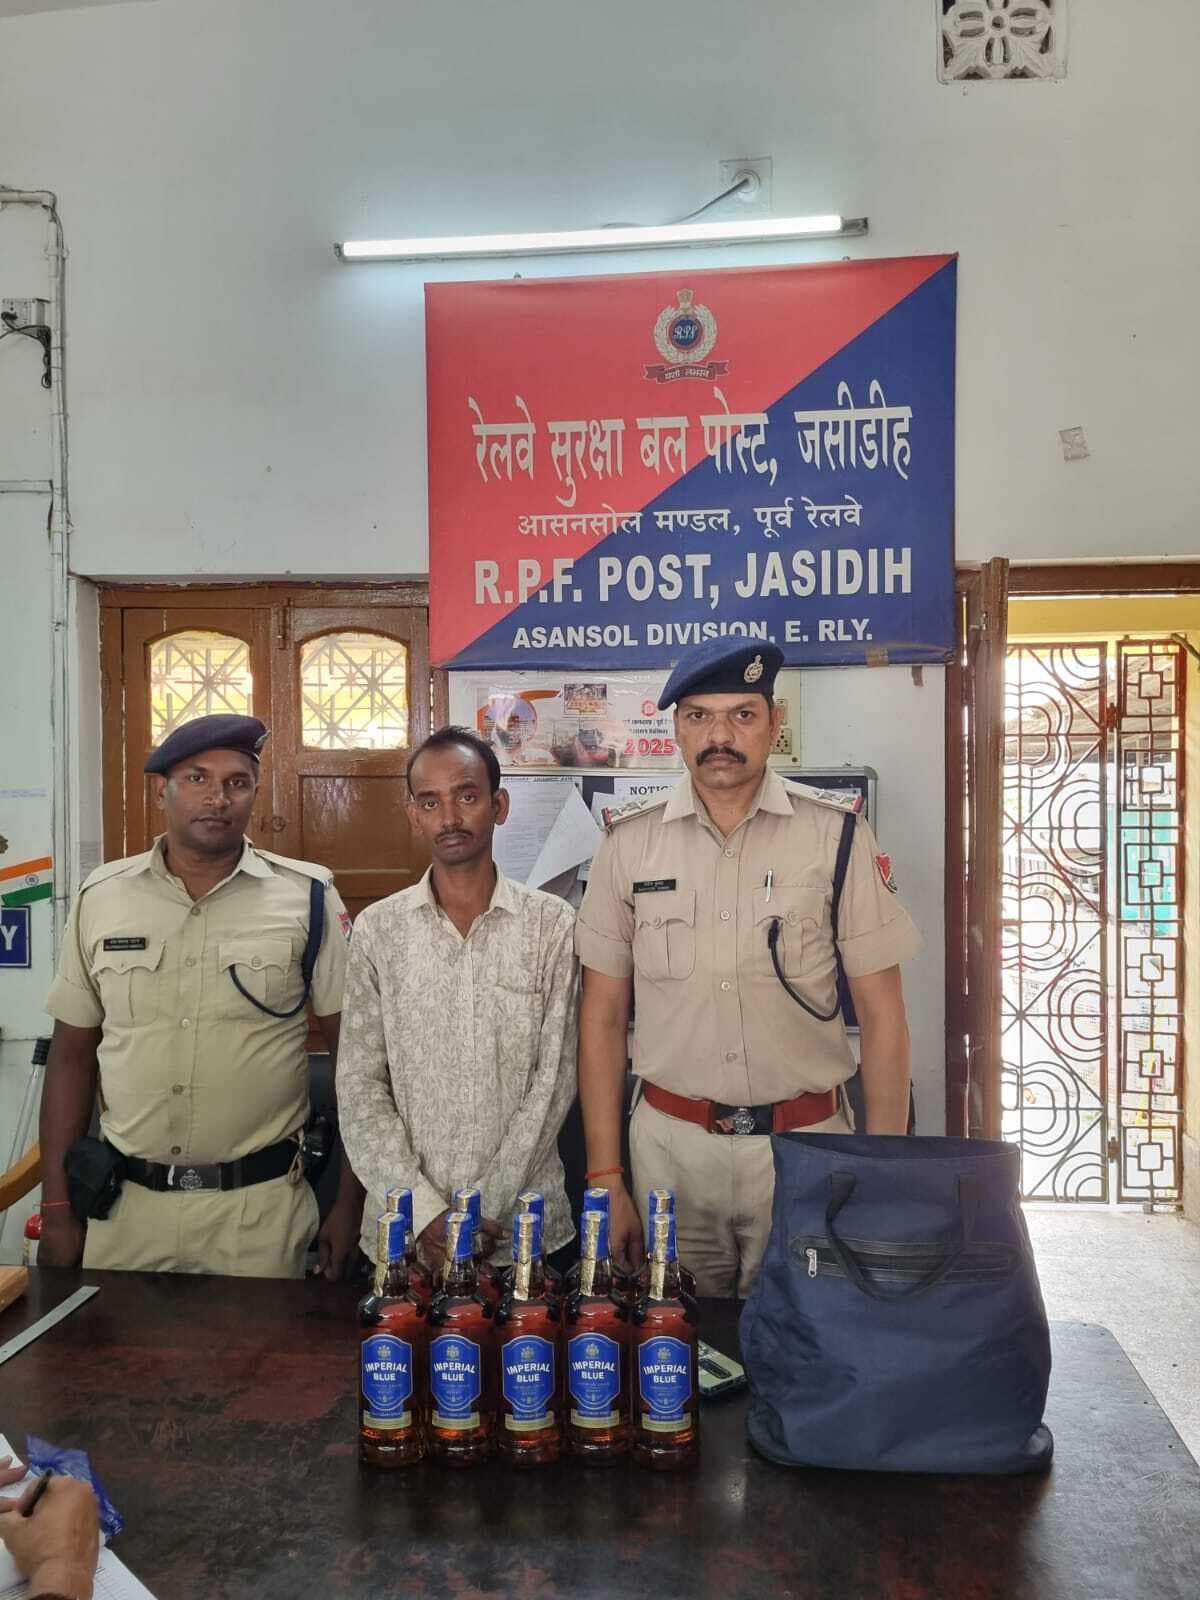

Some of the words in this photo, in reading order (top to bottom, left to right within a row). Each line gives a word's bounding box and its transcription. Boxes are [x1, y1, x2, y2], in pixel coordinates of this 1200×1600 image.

[468, 395, 536, 483] रेलवे
[547, 418, 626, 508] सुरक्षा
[636, 416, 689, 476] बल
[700, 386, 778, 487] पोस्ट,
[794, 379, 913, 480] जसीडीह
[518, 503, 643, 536] आसनसोल
[653, 509, 741, 536] मण्डल,
[753, 497, 794, 538] पूर्व
[801, 494, 863, 528] रेलवे
[474, 558, 583, 604] R.P.F.
[599, 554, 720, 610] POST,
[735, 547, 912, 598] JASIDIH
[512, 626, 638, 649] ASANSOL
[785, 620, 809, 642] E.
[818, 618, 873, 642] RLY.
[624, 738, 674, 756] 2025
[365, 1362, 408, 1372] IMPERIAL
[434, 1362, 475, 1373] IMPERIAL
[506, 1362, 551, 1375] IMPERIAL
[572, 1361, 616, 1372] IMPERIAL
[643, 1364, 687, 1375] IMPERIAL
[373, 1372, 397, 1381] BLUE
[442, 1372, 464, 1381] BLUE
[516, 1373, 541, 1383] BLUE
[581, 1371, 605, 1380] BLUE
[652, 1375, 677, 1383] BLUE
